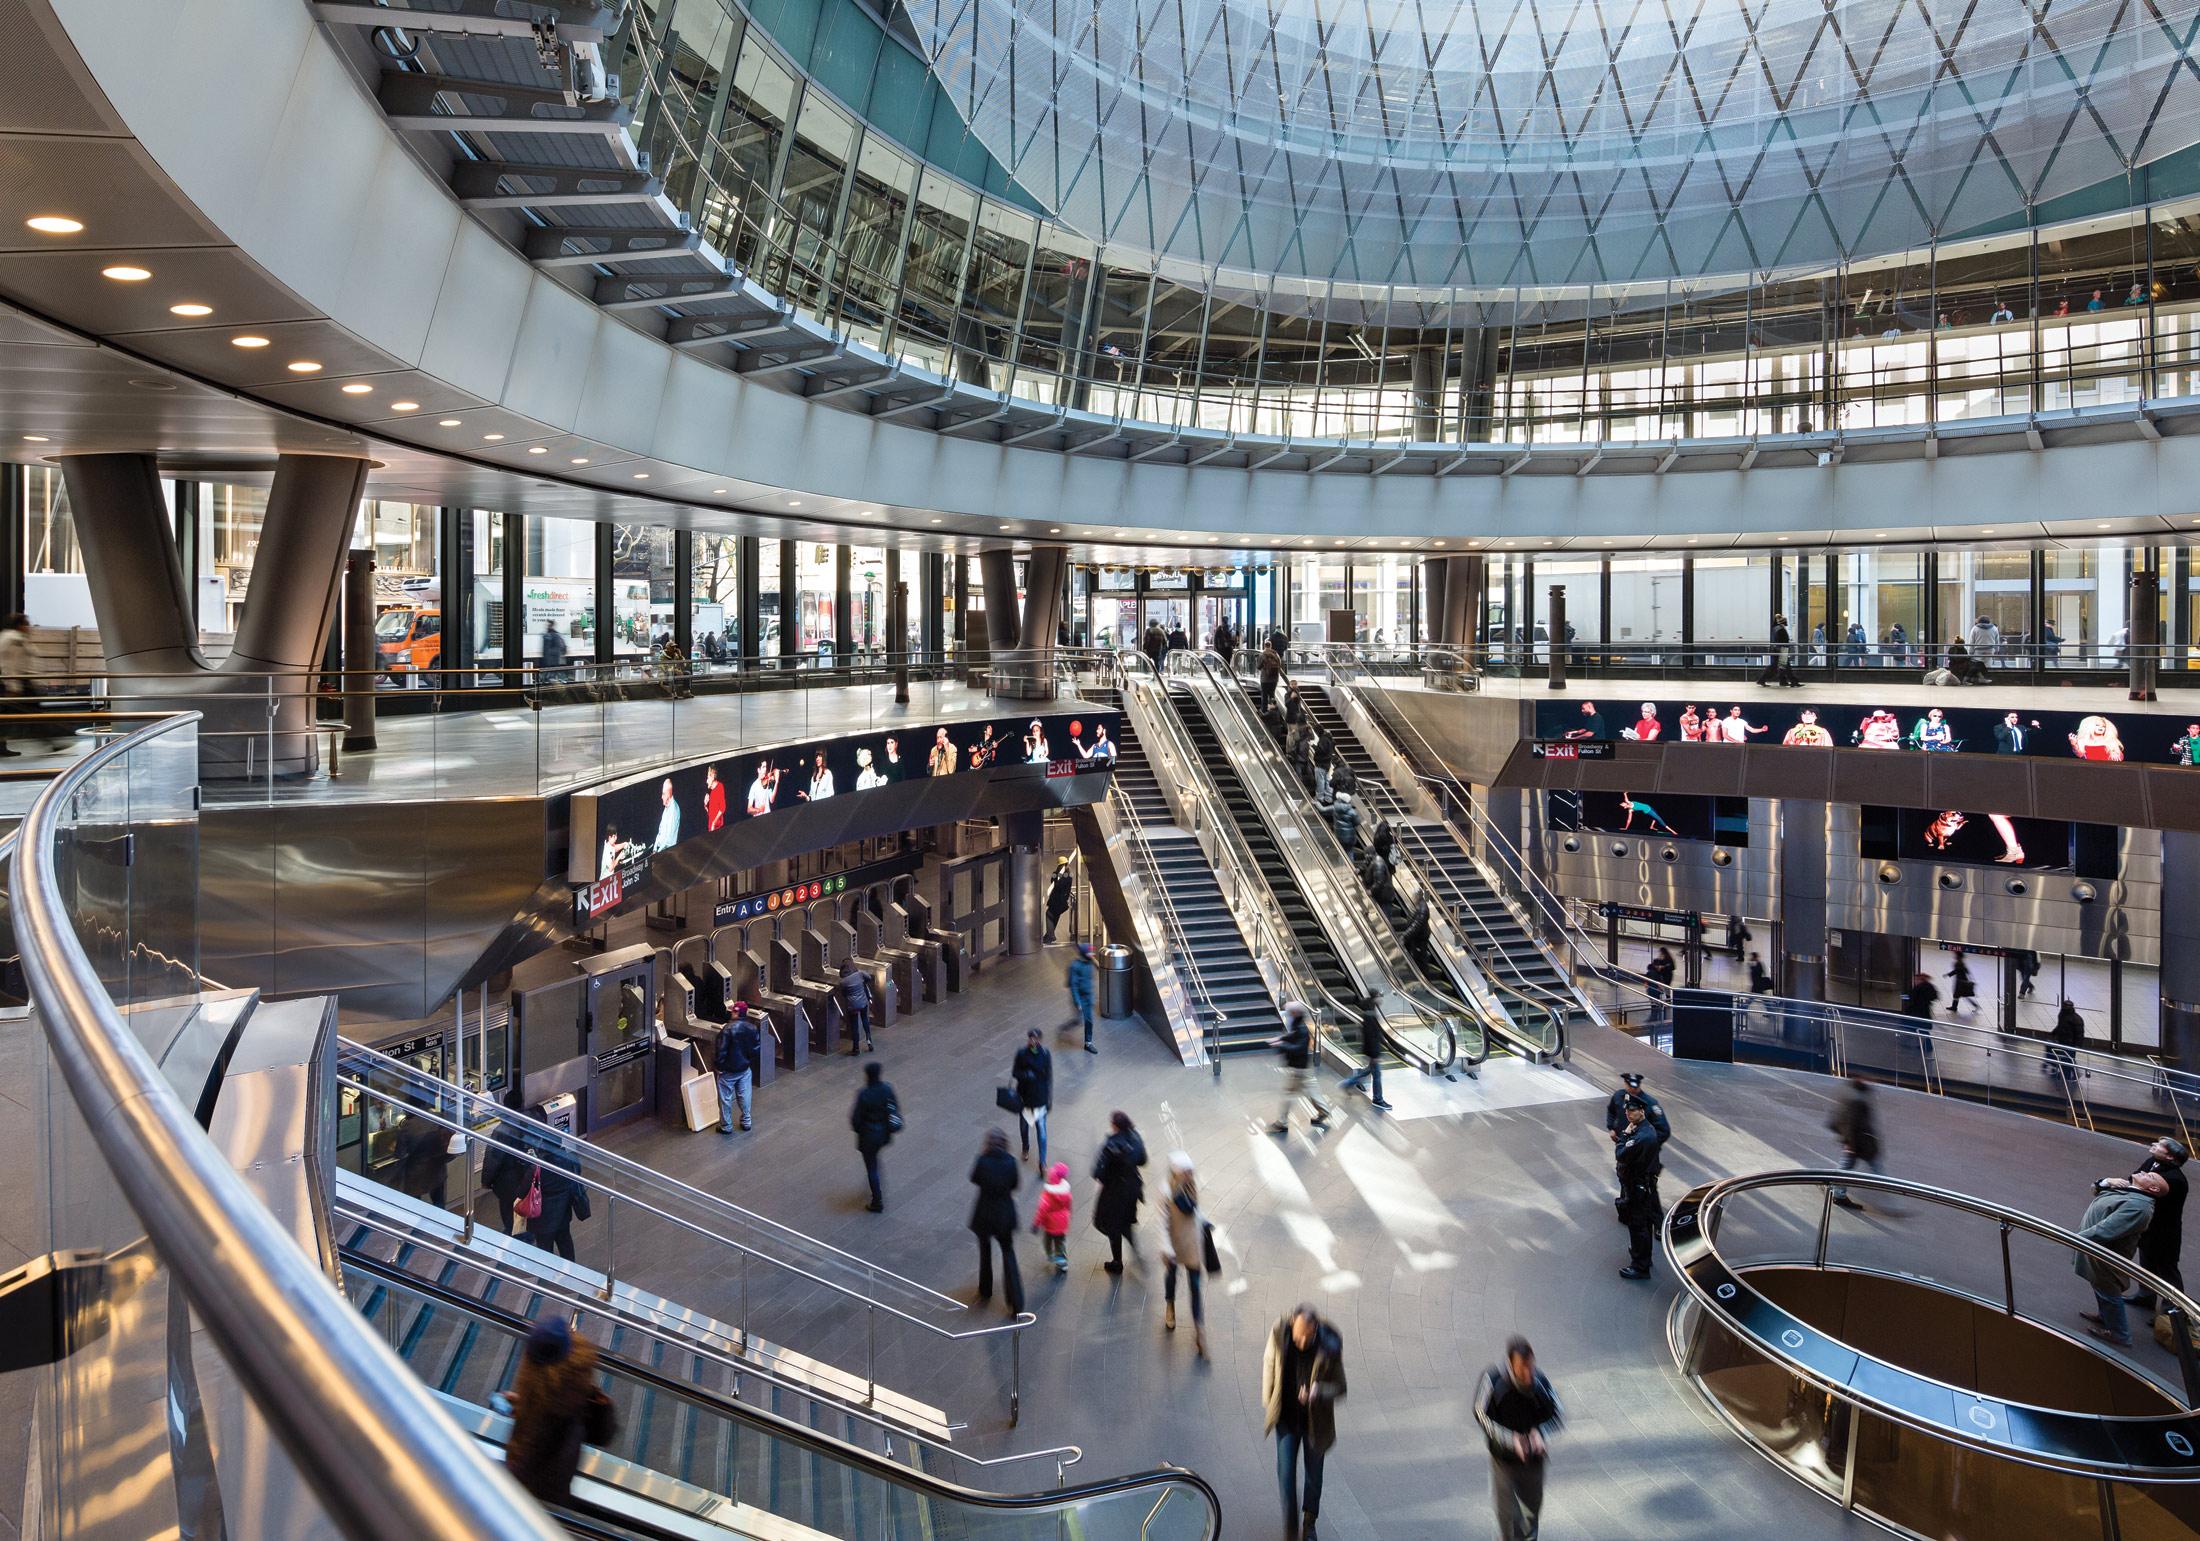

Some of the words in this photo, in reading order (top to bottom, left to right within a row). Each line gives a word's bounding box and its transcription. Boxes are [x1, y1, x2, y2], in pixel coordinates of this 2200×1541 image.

[529, 589, 568, 600] freshdirect
[1545, 743, 1575, 757] Exit
[1047, 760, 1072, 775] Exit
[622, 863, 643, 878] Broadway
[645, 858, 649, 868] &
[622, 878, 633, 889] John
[634, 873, 640, 883] St
[591, 876, 618, 911] Exit
[716, 904, 737, 916] Entry
[740, 905, 748, 916] A
[755, 901, 763, 911] C
[771, 897, 777, 907] J
[785, 893, 791, 903] Z
[800, 889, 805, 899] 2
[812, 885, 819, 895] 3
[825, 881, 831, 891] 4
[838, 878, 844, 888] 5
[403, 1041, 415, 1052] St
[554, 1116, 569, 1125] Entry
